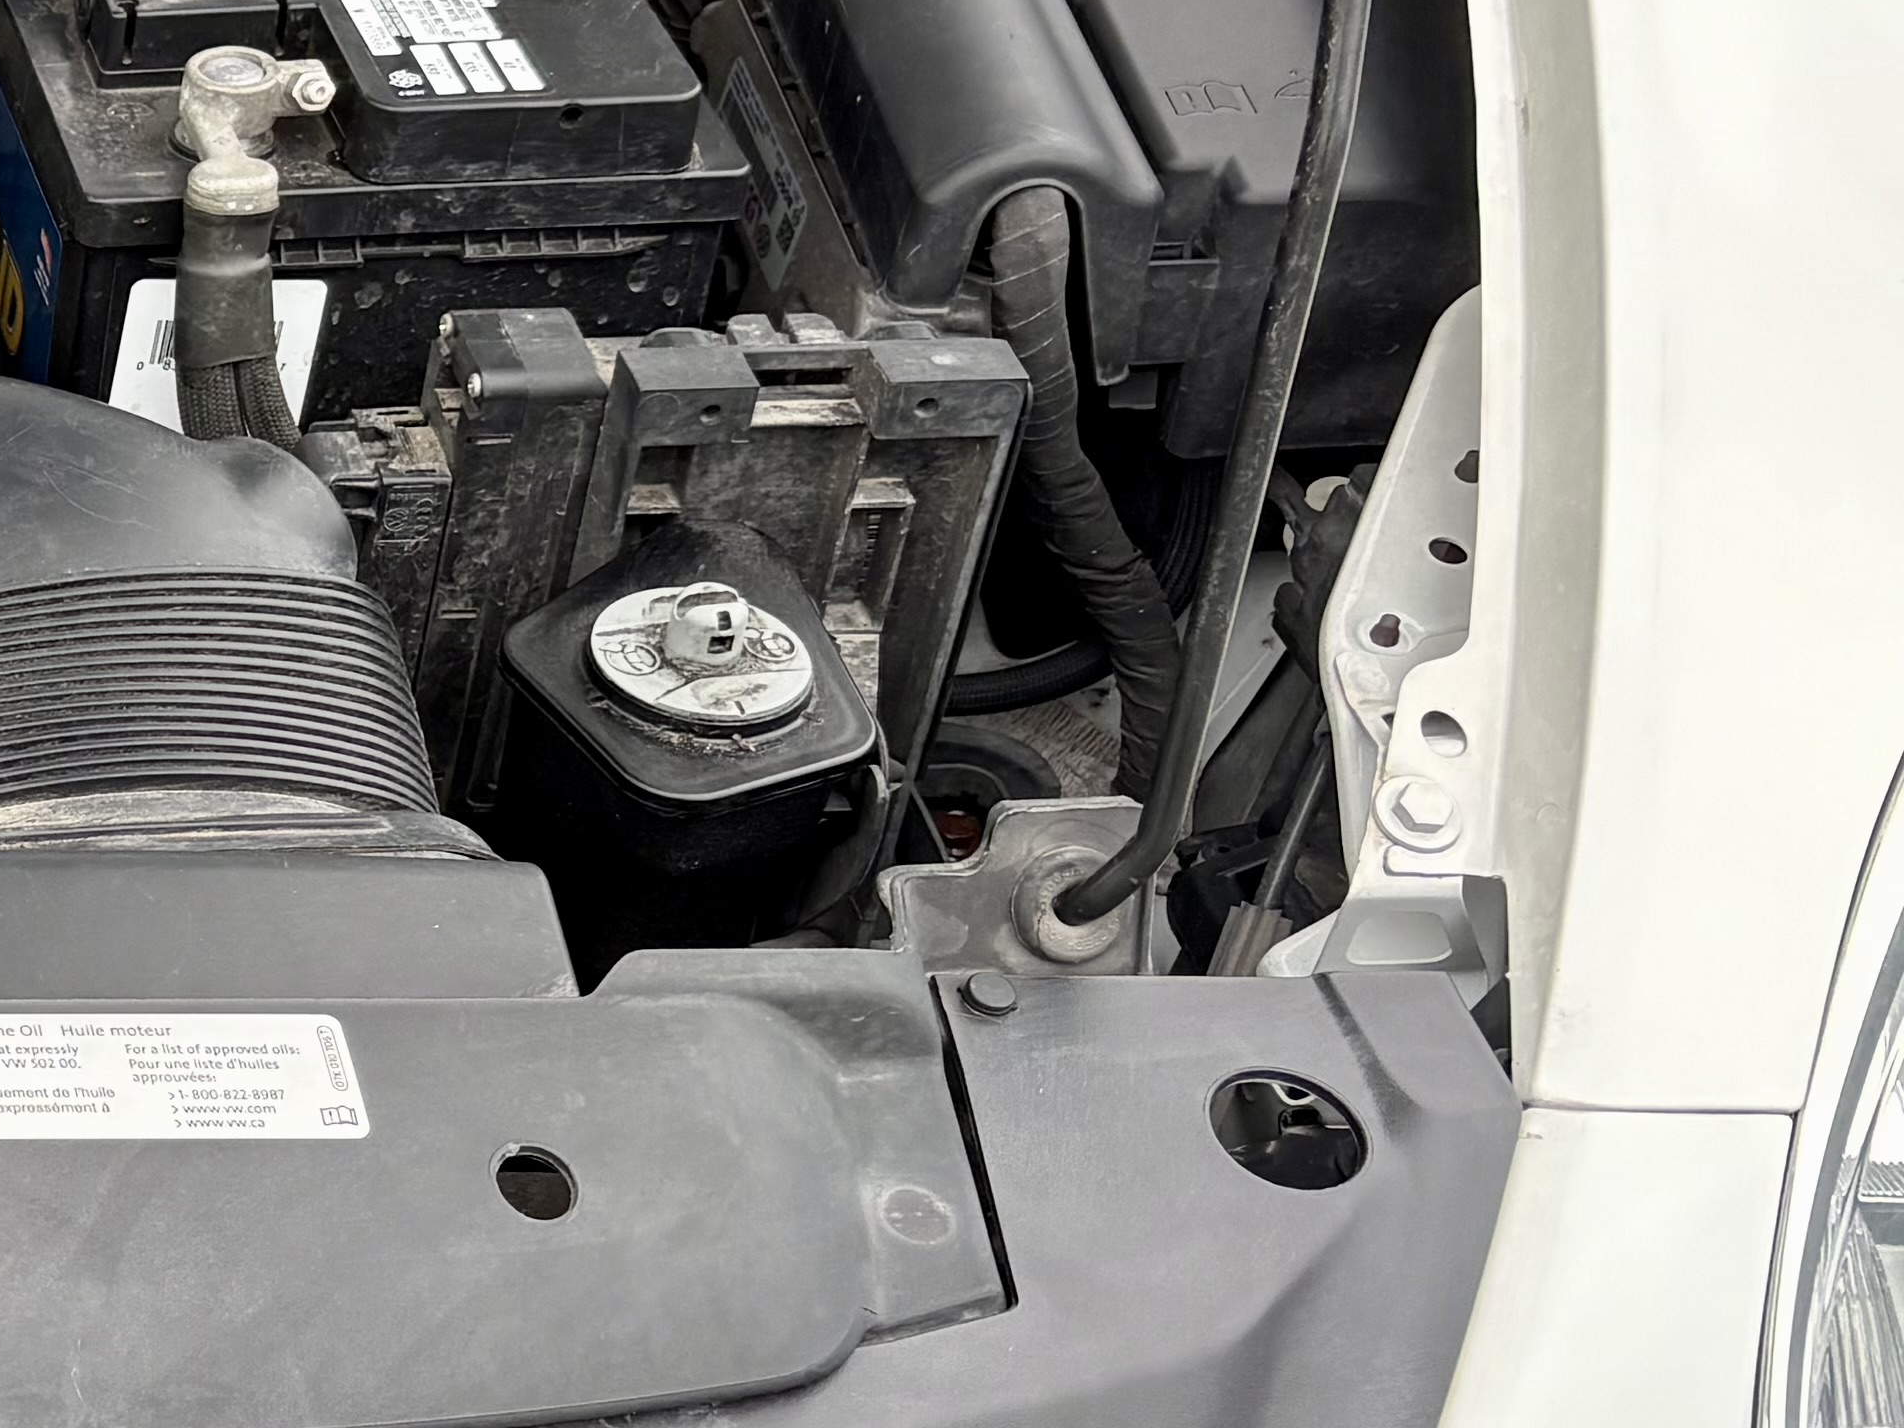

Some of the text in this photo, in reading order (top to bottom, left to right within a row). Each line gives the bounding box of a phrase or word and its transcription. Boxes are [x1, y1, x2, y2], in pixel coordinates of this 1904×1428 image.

[19, 1024, 43, 1037] Oil
[60, 1024, 172, 1037] Huile moteur
[15, 1043, 79, 1057] expressly
[124, 1043, 301, 1057] For a list of approved oils:
[1, 1058, 27, 1069] VW
[31, 1058, 56, 1069] 502
[59, 1058, 82, 1069] 00.
[128, 1058, 280, 1070] Pour une liste d'huiles
[132, 1072, 217, 1085] approuvées:
[52, 1087, 70, 1098] de
[182, 1104, 277, 1114] www.vw.com
[185, 1119, 266, 1128] www.vw.ca
